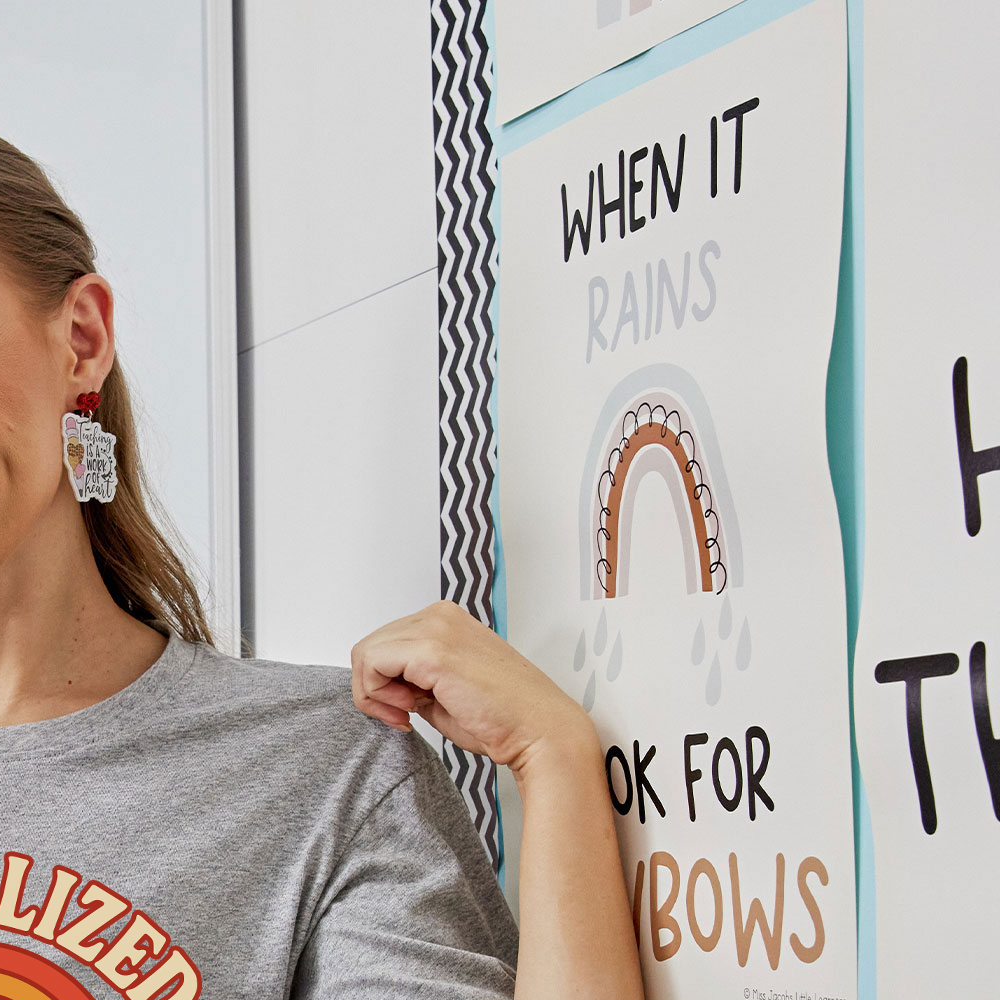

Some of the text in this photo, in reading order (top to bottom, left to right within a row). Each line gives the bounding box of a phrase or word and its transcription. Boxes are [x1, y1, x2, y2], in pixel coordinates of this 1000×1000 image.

[561, 97, 760, 263] WHEN IT
[586, 240, 721, 363] RAINS
[76, 419, 113, 454] Teaching
[96, 445, 100, 458] A
[87, 458, 107, 472] WORK
[92, 473, 100, 484] OF
[85, 473, 114, 498] heart
[605, 726, 775, 824] OK FOR
[634, 851, 829, 971] BOWS
[752, 988, 767, 1000] Miss
